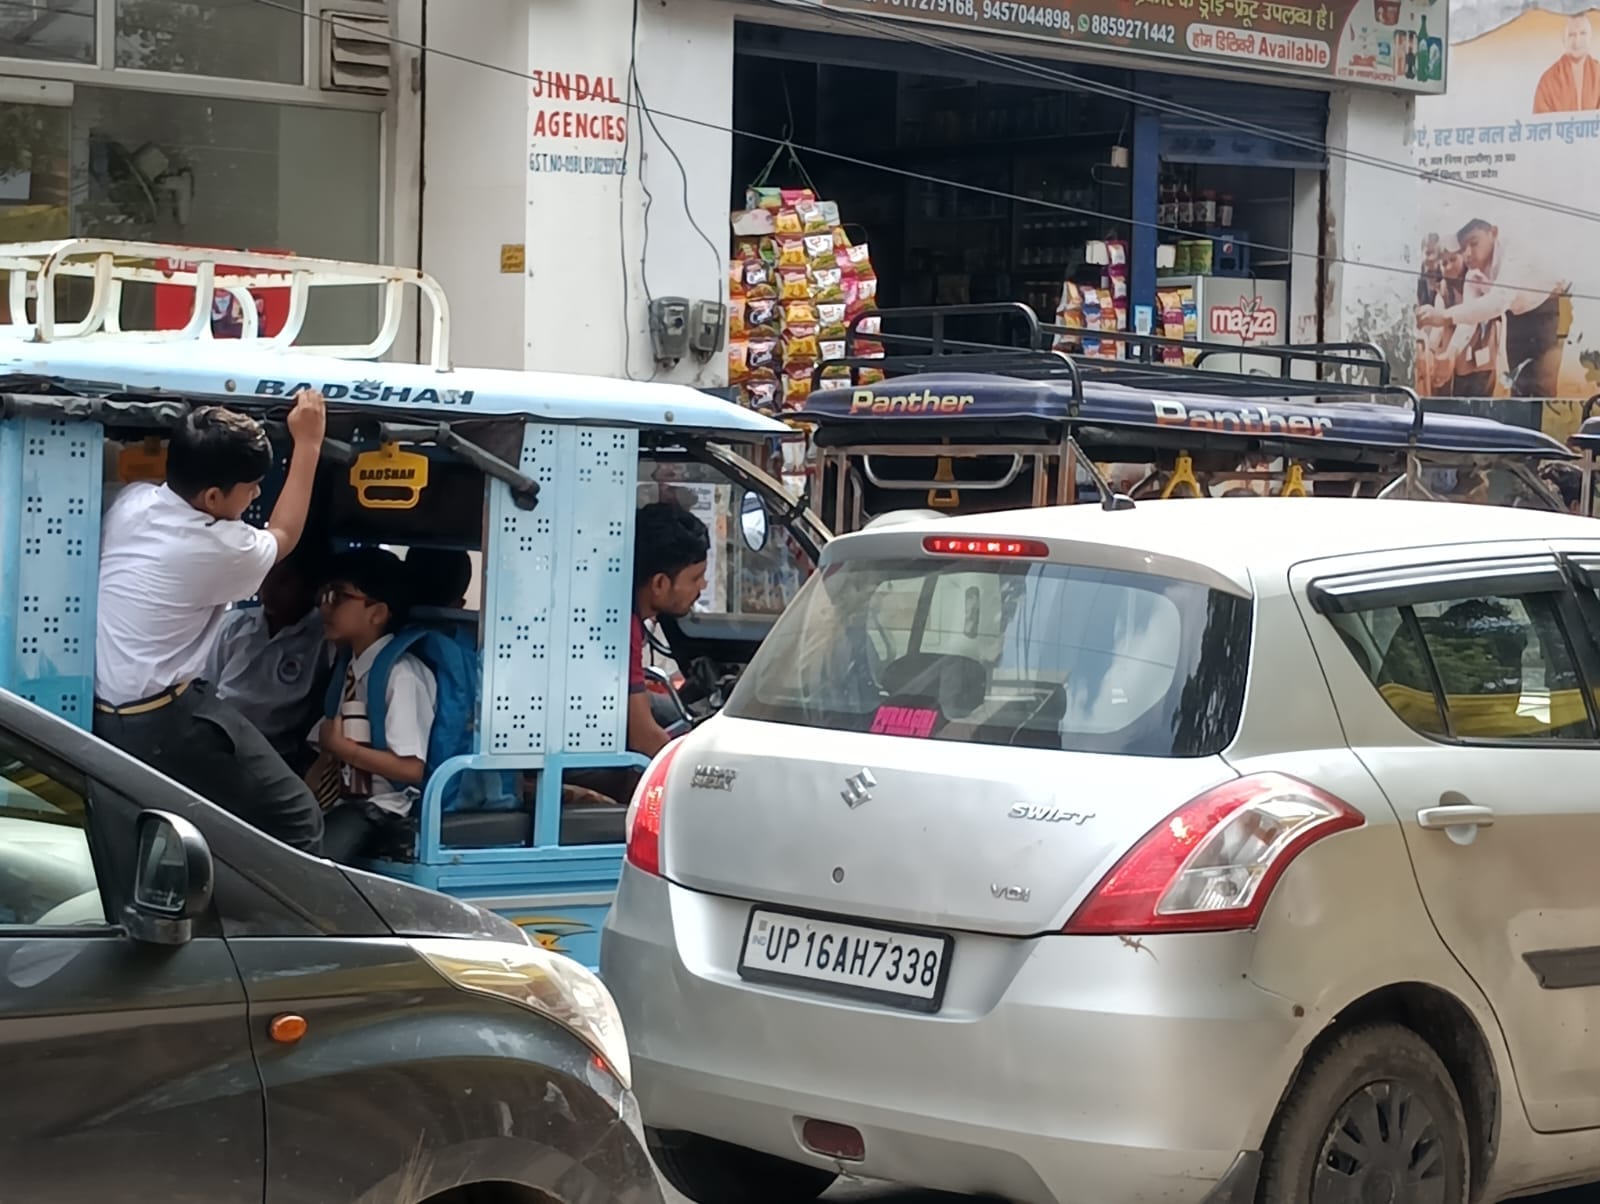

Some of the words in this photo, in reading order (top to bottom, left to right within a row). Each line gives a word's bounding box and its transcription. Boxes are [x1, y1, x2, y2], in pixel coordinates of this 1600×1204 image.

[983, 4, 1075, 34] 9457044898,
[1091, 14, 1175, 44] 8859271442
[1258, 36, 1327, 65] Available
[532, 69, 620, 104] JINDAL
[533, 110, 625, 143] AGENCIES
[1477, 125, 1506, 145] नल
[1508, 119, 1523, 143] से
[1525, 122, 1554, 143] जल
[849, 388, 975, 415] Panther
[1152, 400, 1333, 438] Panther
[359, 467, 416, 481] BADSHAH
[1007, 801, 1096, 827] SWIFT
[765, 924, 939, 987] UP16AH7338
